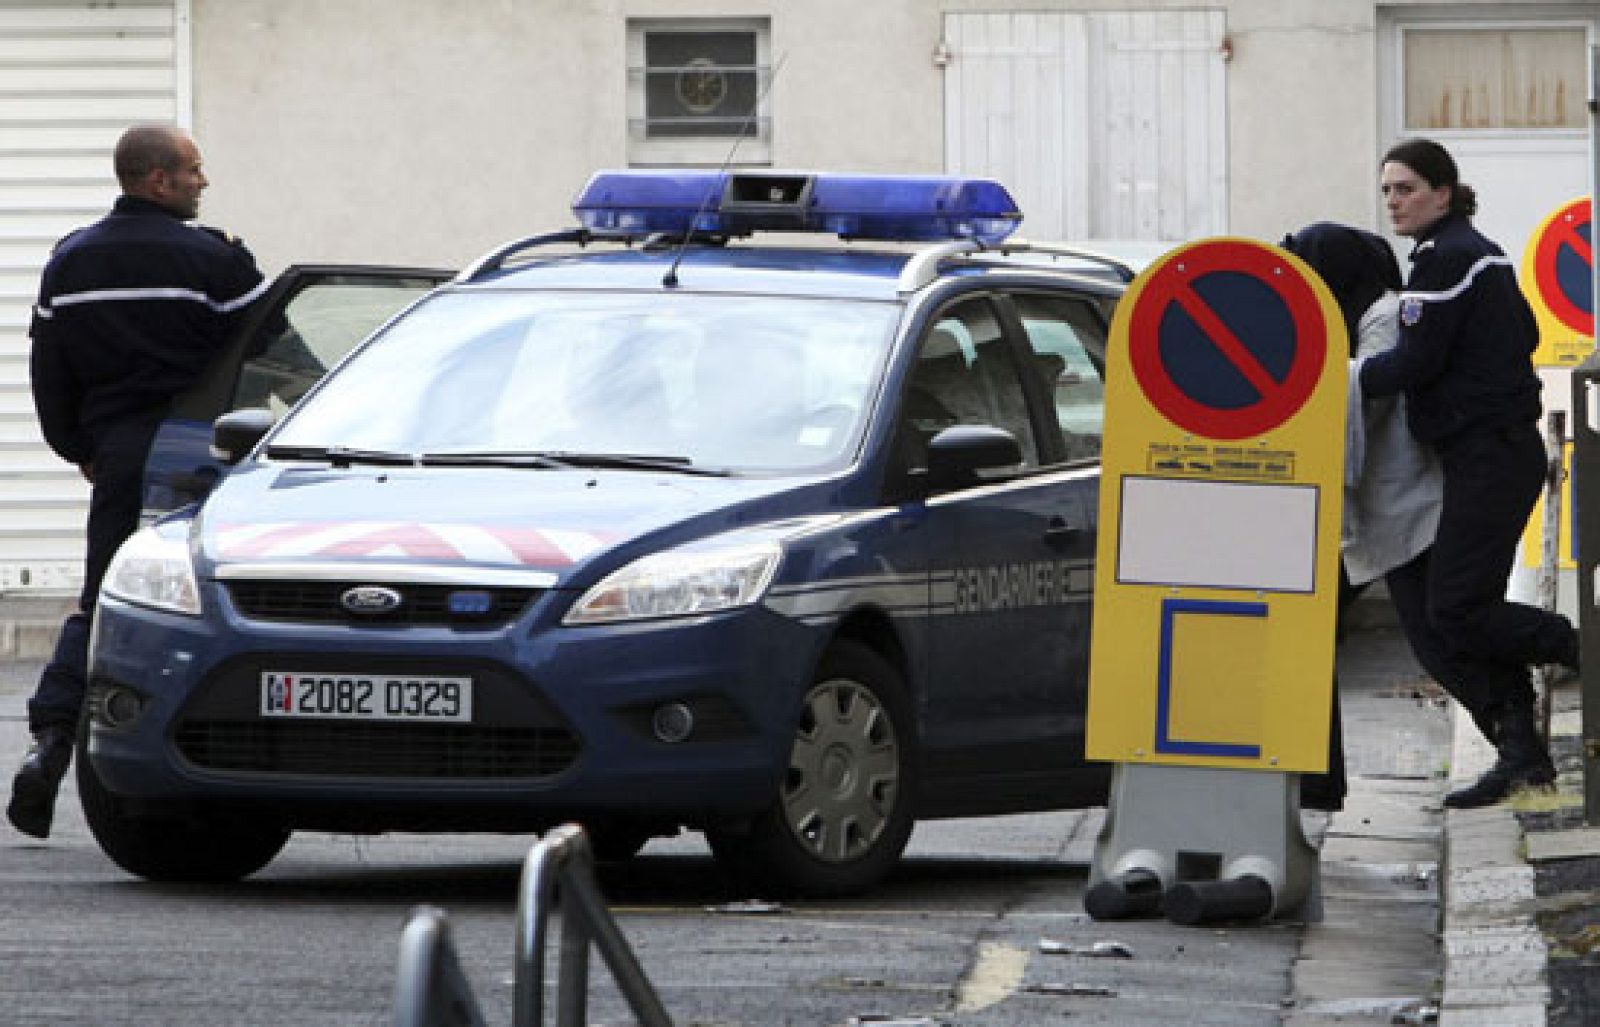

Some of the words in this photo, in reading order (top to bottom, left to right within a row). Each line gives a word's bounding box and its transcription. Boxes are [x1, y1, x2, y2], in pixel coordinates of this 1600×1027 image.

[954, 559, 1070, 615] GENDARMERIE
[299, 677, 374, 714] 2082
[385, 680, 461, 716] 0329
